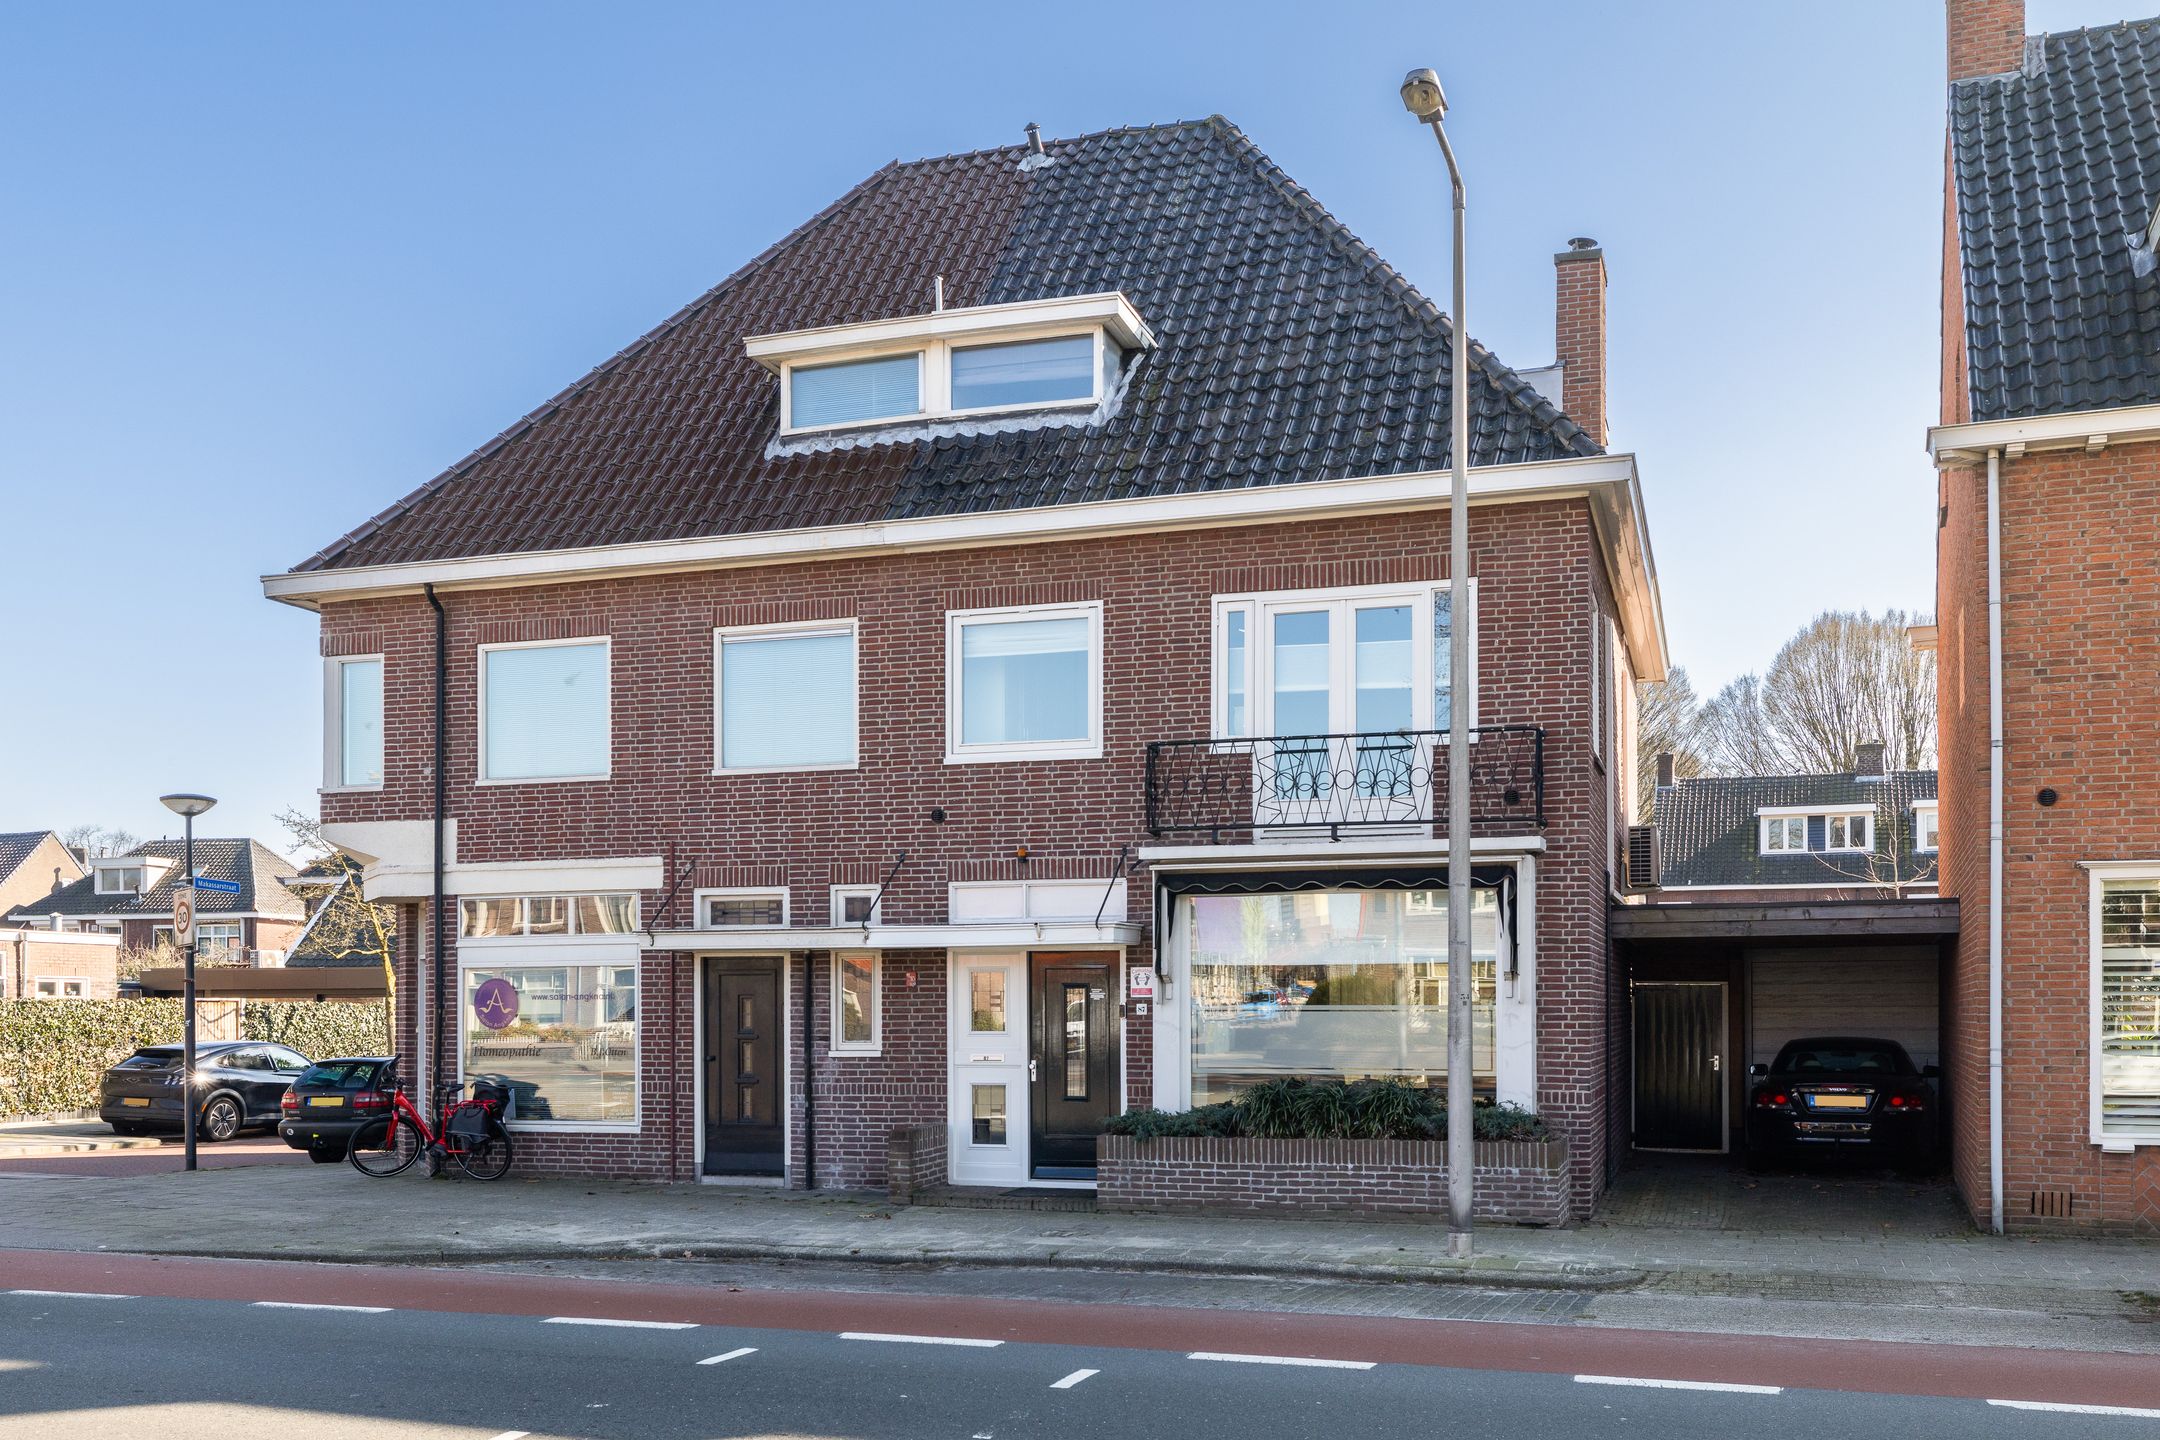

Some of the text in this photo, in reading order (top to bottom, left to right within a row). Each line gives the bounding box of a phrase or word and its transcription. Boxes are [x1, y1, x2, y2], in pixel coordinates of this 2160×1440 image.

[198, 880, 237, 891] Makassarstraat
[178, 911, 187, 924] 30
[473, 1044, 541, 1059] Homeopathie
